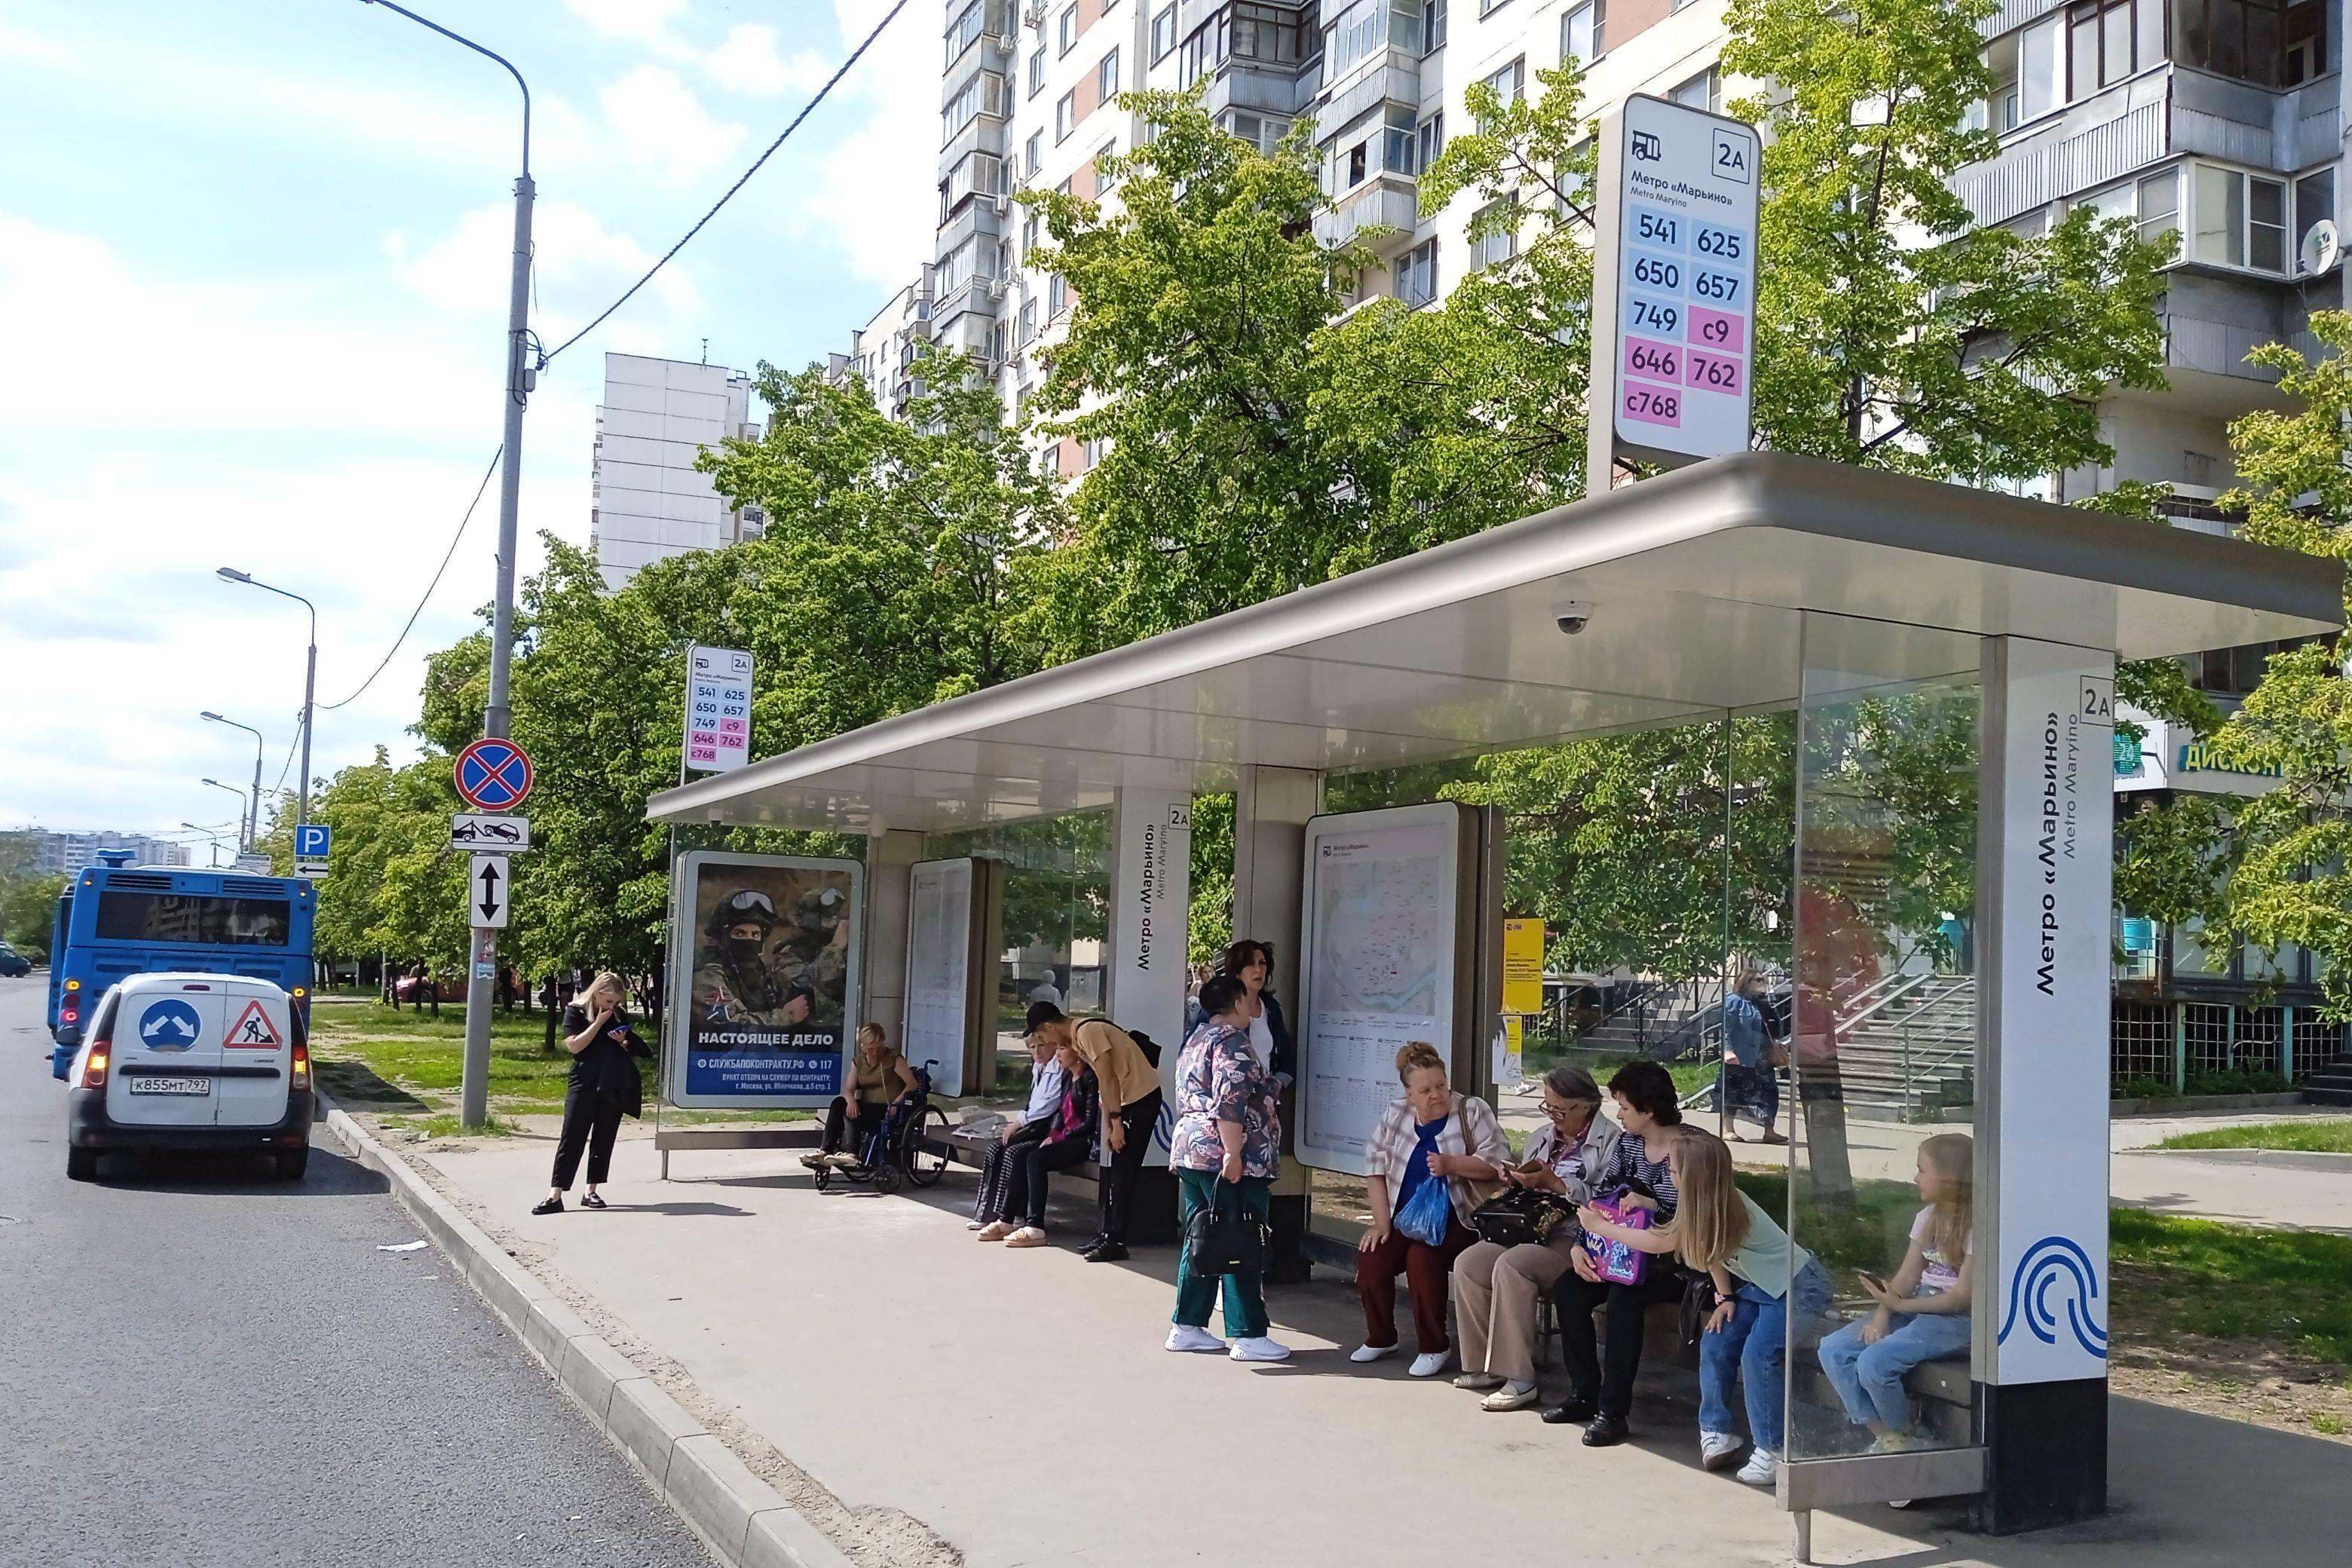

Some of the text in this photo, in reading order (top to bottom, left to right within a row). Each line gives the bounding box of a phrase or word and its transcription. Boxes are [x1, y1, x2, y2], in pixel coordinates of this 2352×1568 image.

[1719, 143, 1744, 171] 2А
[1630, 186, 1687, 207] Metro Maryino
[1631, 170, 1732, 206] Метро «Марьино»
[1639, 213, 1740, 259] 541 625
[1634, 258, 1738, 301] 650 657
[1634, 301, 1729, 342] 749 с9
[1632, 346, 1735, 388] 646 762
[1627, 392, 1677, 418] с768
[734, 659, 747, 669] 2А
[698, 687, 745, 700] 541 625
[2084, 688, 2110, 717] 2А
[696, 702, 744, 715] 650 657
[695, 718, 739, 731] 749 с9
[694, 733, 742, 747] 646 762
[692, 749, 715, 759] с768
[2063, 714, 2079, 859] Metro Maryino
[1171, 810, 1188, 825] 2А
[305, 829, 324, 853] P
[1156, 825, 1168, 899] Metro Maryino
[2037, 712, 2060, 997] Метро «Марьино»
[1138, 824, 1154, 971] Метро «Марьино»
[699, 1032, 833, 1046] НАСТОЯЩЕЕ ДЕЛО
[709, 1059, 804, 1069] СЛУЖБАПОКОНТРАКТУ.РФ
[820, 1060, 832, 1069] 117
[136, 1080, 206, 1091] К855МТ 797
